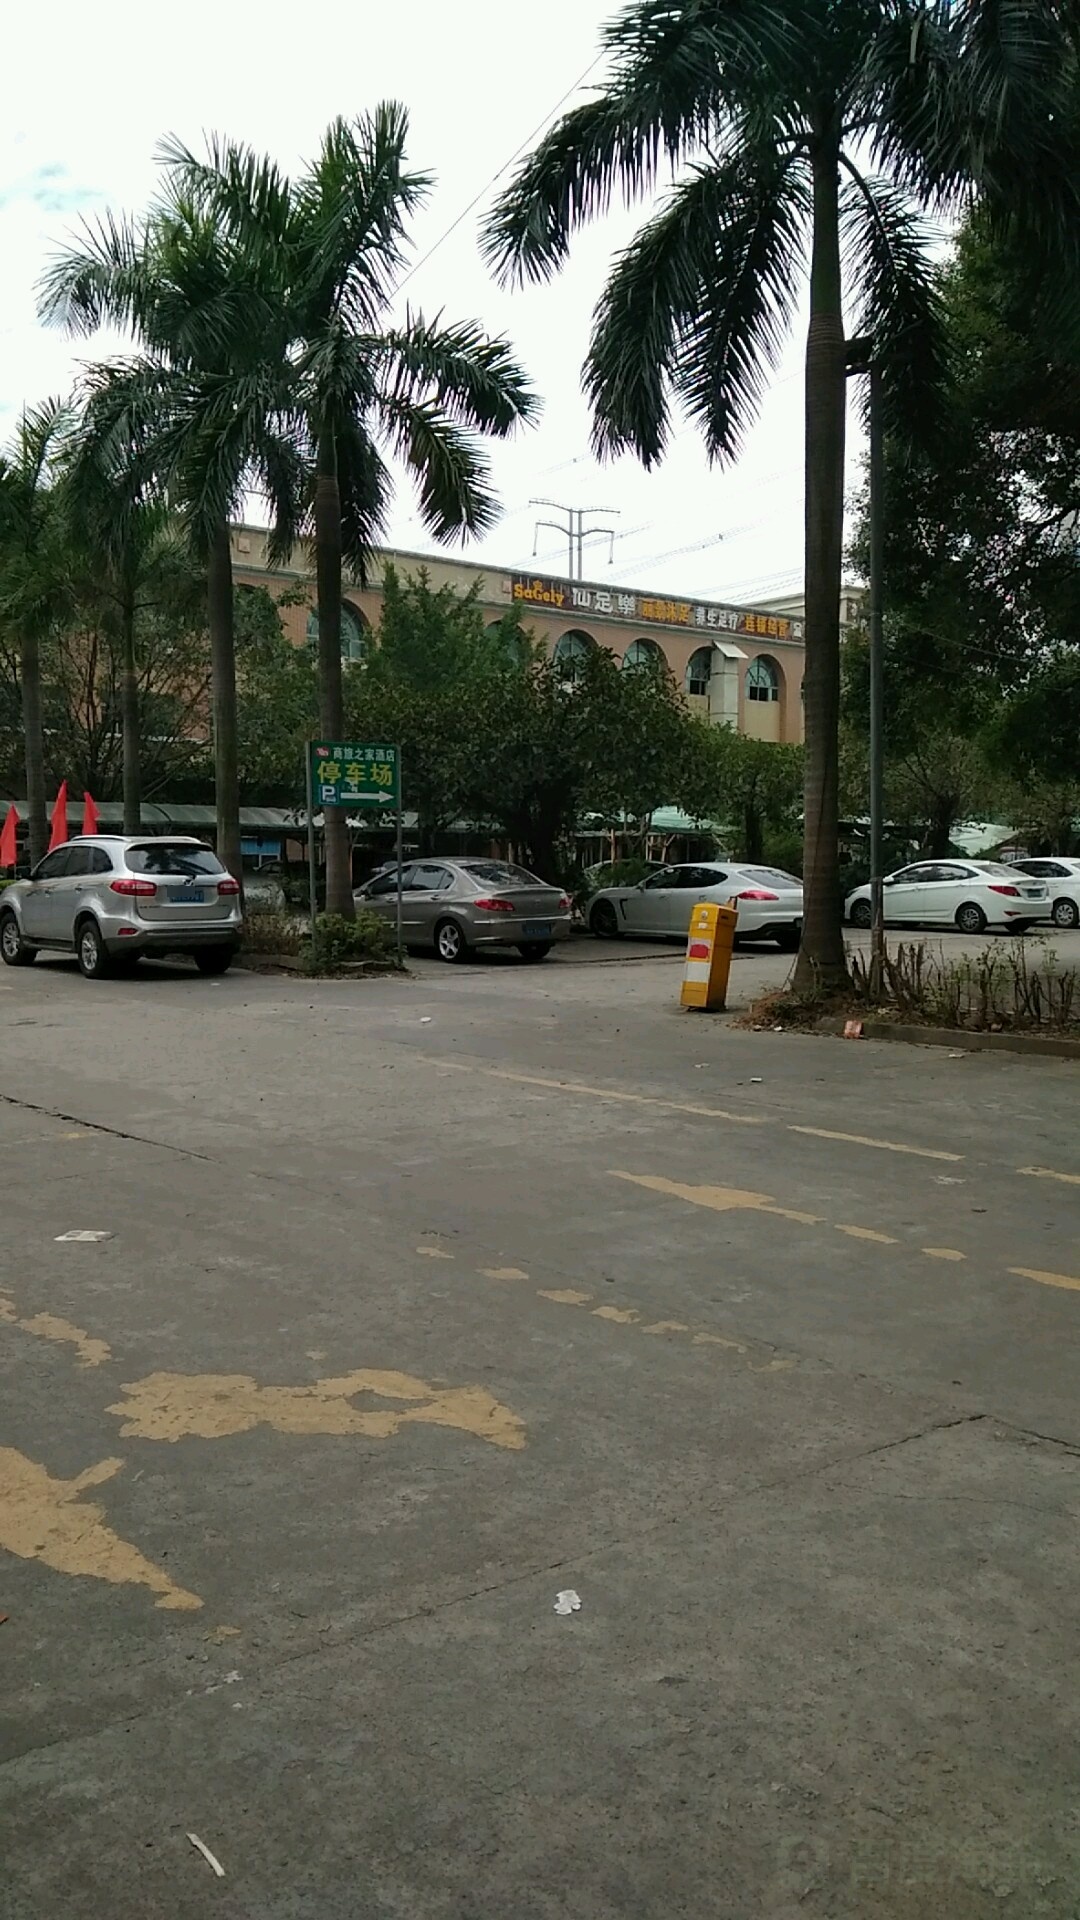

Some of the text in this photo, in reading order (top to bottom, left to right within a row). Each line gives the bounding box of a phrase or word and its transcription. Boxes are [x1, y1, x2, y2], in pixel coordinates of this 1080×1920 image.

[333, 746, 395, 762] 商旅之家酒店
[317, 761, 393, 786] 停车场
[322, 785, 336, 801] P
